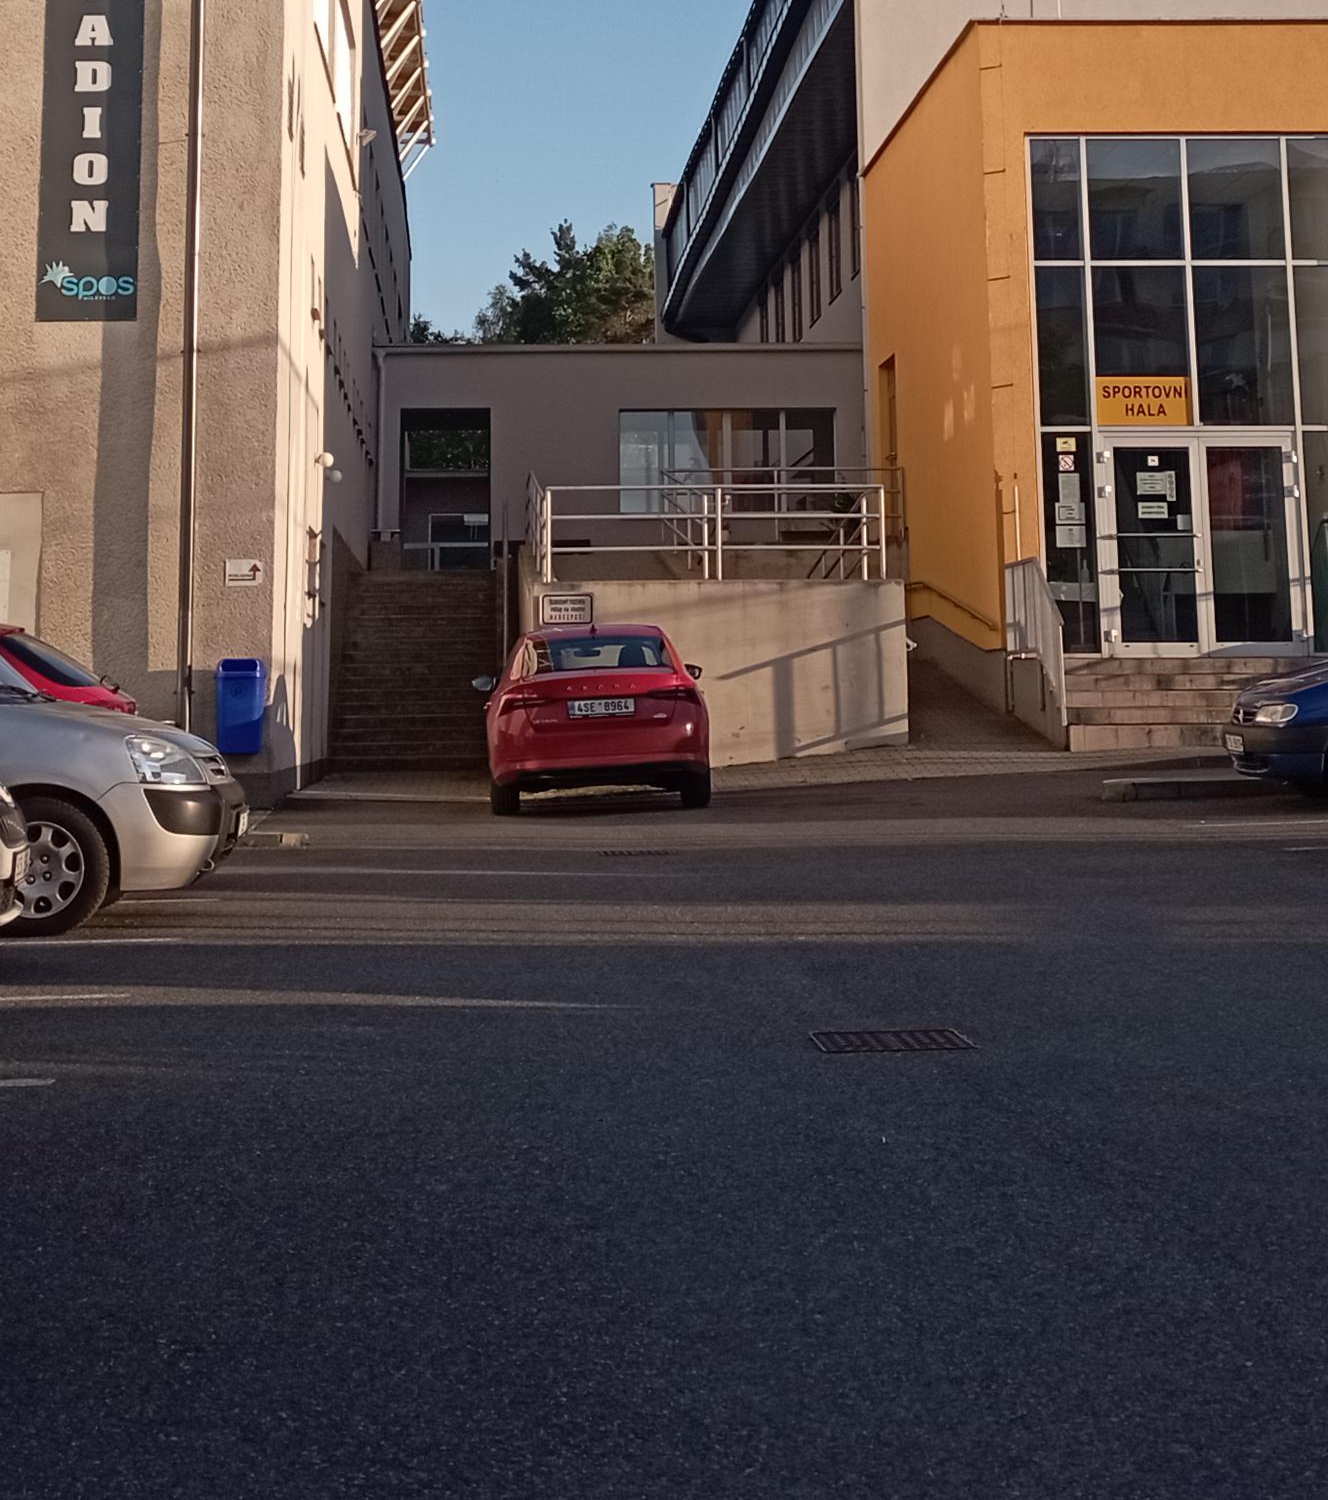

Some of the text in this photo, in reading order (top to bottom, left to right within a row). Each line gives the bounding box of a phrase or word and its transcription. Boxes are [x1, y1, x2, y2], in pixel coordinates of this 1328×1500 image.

[1125, 403, 1167, 417] HALA
[576, 700, 630, 713] 4SE 8964
